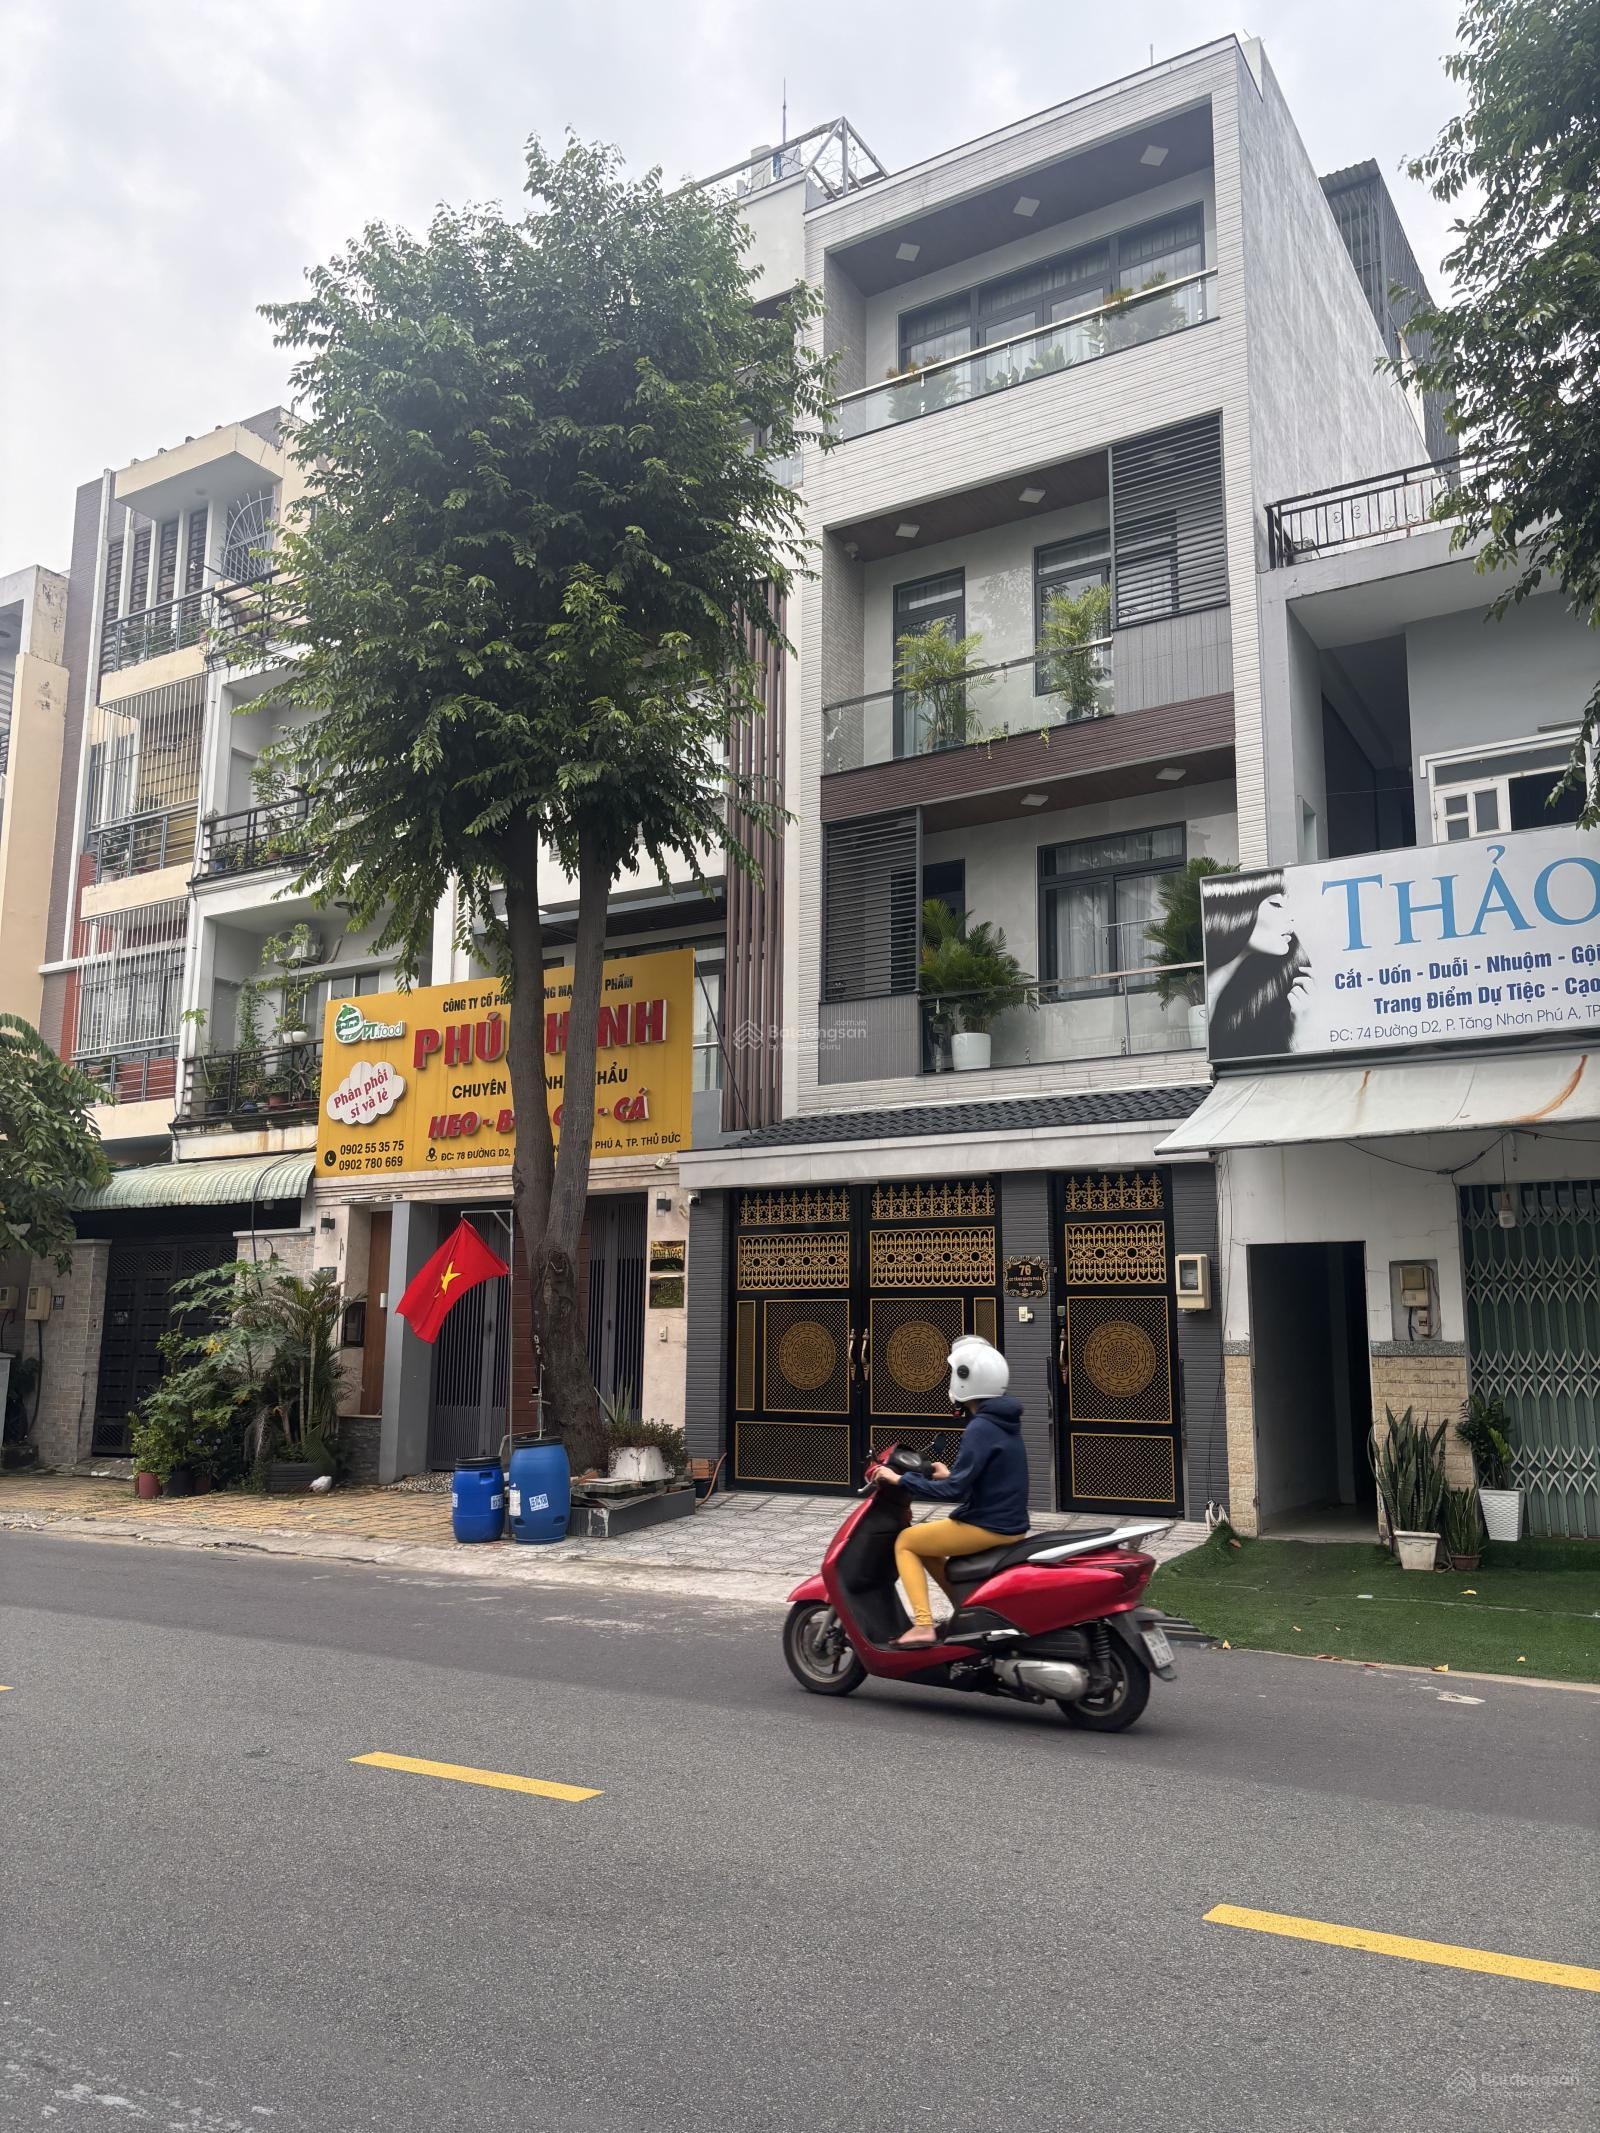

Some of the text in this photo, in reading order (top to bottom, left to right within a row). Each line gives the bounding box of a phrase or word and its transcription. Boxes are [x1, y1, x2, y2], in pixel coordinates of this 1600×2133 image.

[1322, 845, 1600, 952] THẢO
[1334, 968, 1362, 990] Cắt
[1379, 963, 1411, 986] Uốn
[1429, 957, 1468, 979] Duỗi
[1486, 951, 1552, 973] Nhuộm
[443, 998, 466, 1012] CÔNG
[468, 998, 478, 1009] TY
[558, 984, 572, 999] MẠ
[1373, 996, 1422, 1015] Trang
[1426, 985, 1472, 1010] Điểm
[1478, 986, 1502, 1007] Dự
[1508, 981, 1546, 1003] Tiệc
[413, 1000, 667, 1069] PHÚ HNH
[1330, 1029, 1353, 1043] ĐC:
[1356, 1028, 1371, 1040] 74
[1374, 1022, 1418, 1039] Đường
[1421, 1020, 1442, 1035] D2,
[1446, 1018, 1456, 1031] P.
[1459, 1014, 1493, 1031] Tăng
[1496, 1011, 1533, 1027] Nhơn
[1536, 1007, 1563, 1022] Phú
[1567, 1007, 1581, 1020] A,
[452, 1078, 507, 1098] CHUYÊN
[594, 1061, 628, 1085] HẨU
[334, 1087, 362, 1109] Phân
[362, 1096, 375, 1111] và
[613, 1087, 649, 1124] CÁ
[340, 1140, 404, 1155] 0902 55 35 75
[456, 1151, 465, 1160] 78
[467, 1147, 496, 1159] ĐƯỜNG
[595, 1137, 613, 1149] PHÚ
[626, 1138, 639, 1147] TP.
[641, 1132, 659, 1145] THỦ
[661, 1131, 681, 1143] ĐỨC
[339, 1156, 403, 1171] 0902 780 669
[1019, 1264, 1031, 1276] 76
